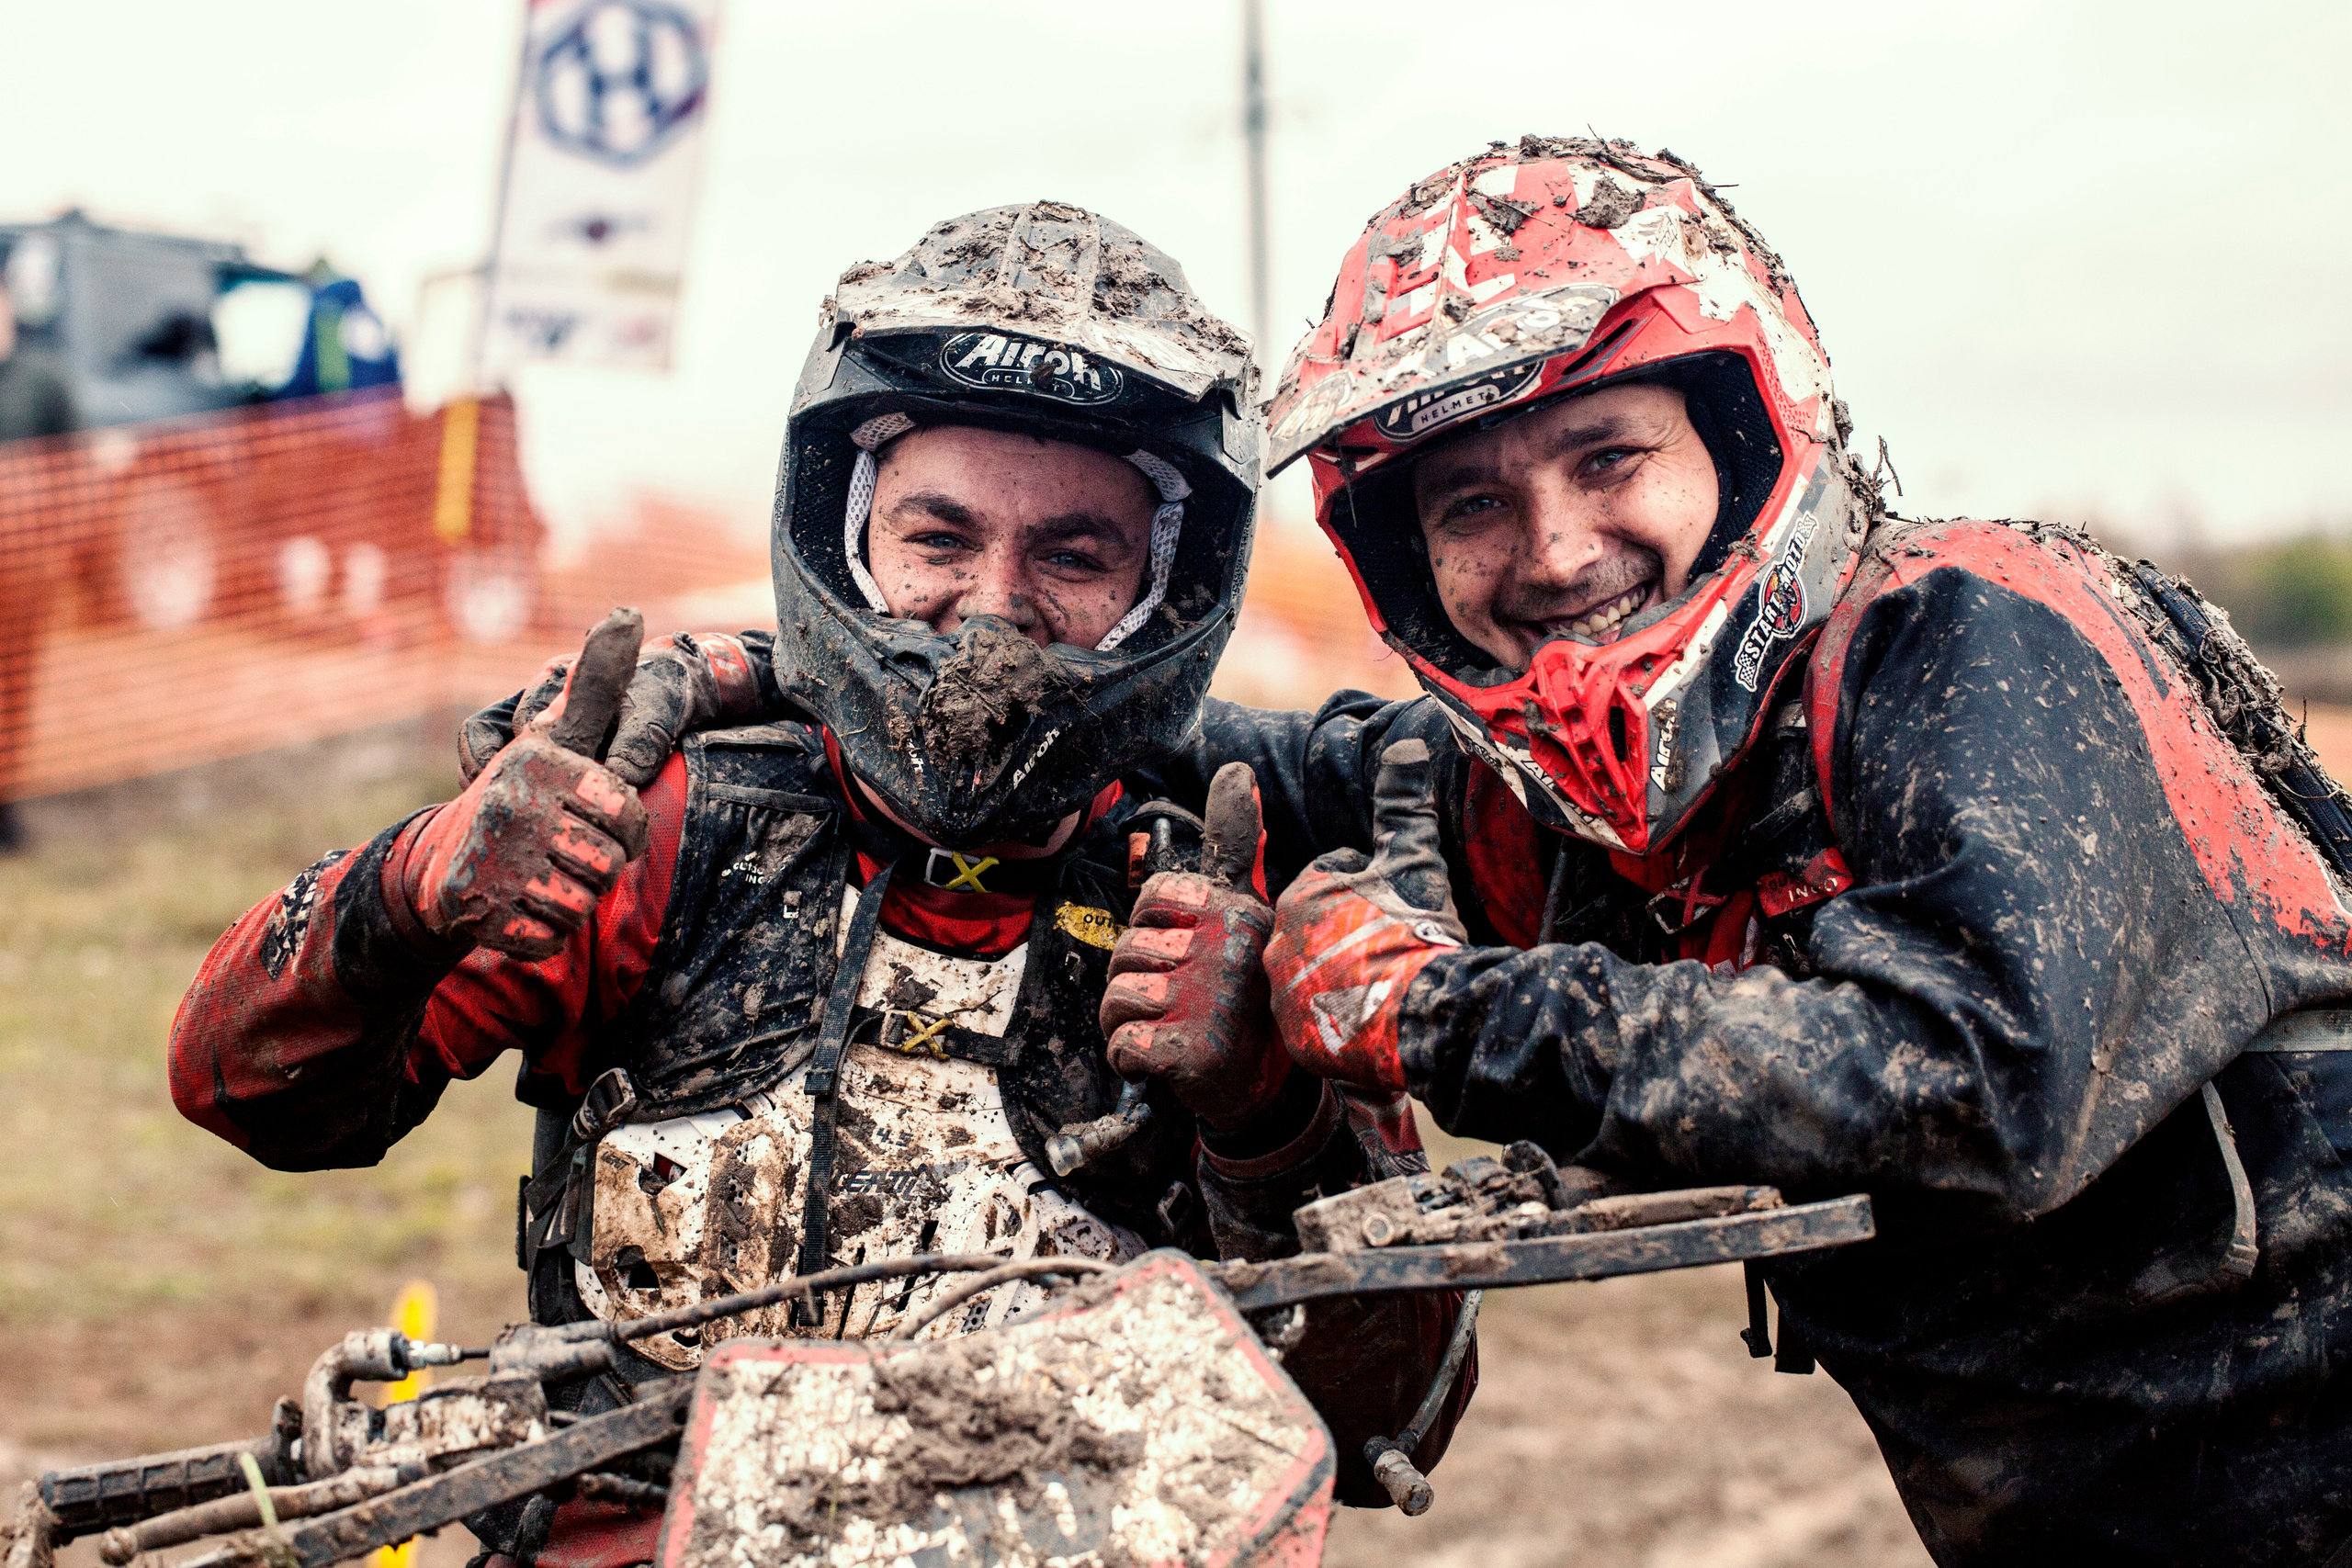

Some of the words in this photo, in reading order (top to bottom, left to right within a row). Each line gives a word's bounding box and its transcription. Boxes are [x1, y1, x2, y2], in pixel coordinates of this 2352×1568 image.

[991, 373, 1060, 392] HELT
[1420, 391, 1486, 423] HELMET
[1745, 592, 1781, 660] START
[1781, 531, 1807, 591] MOTO
[876, 1127, 914, 1147] 4.5
